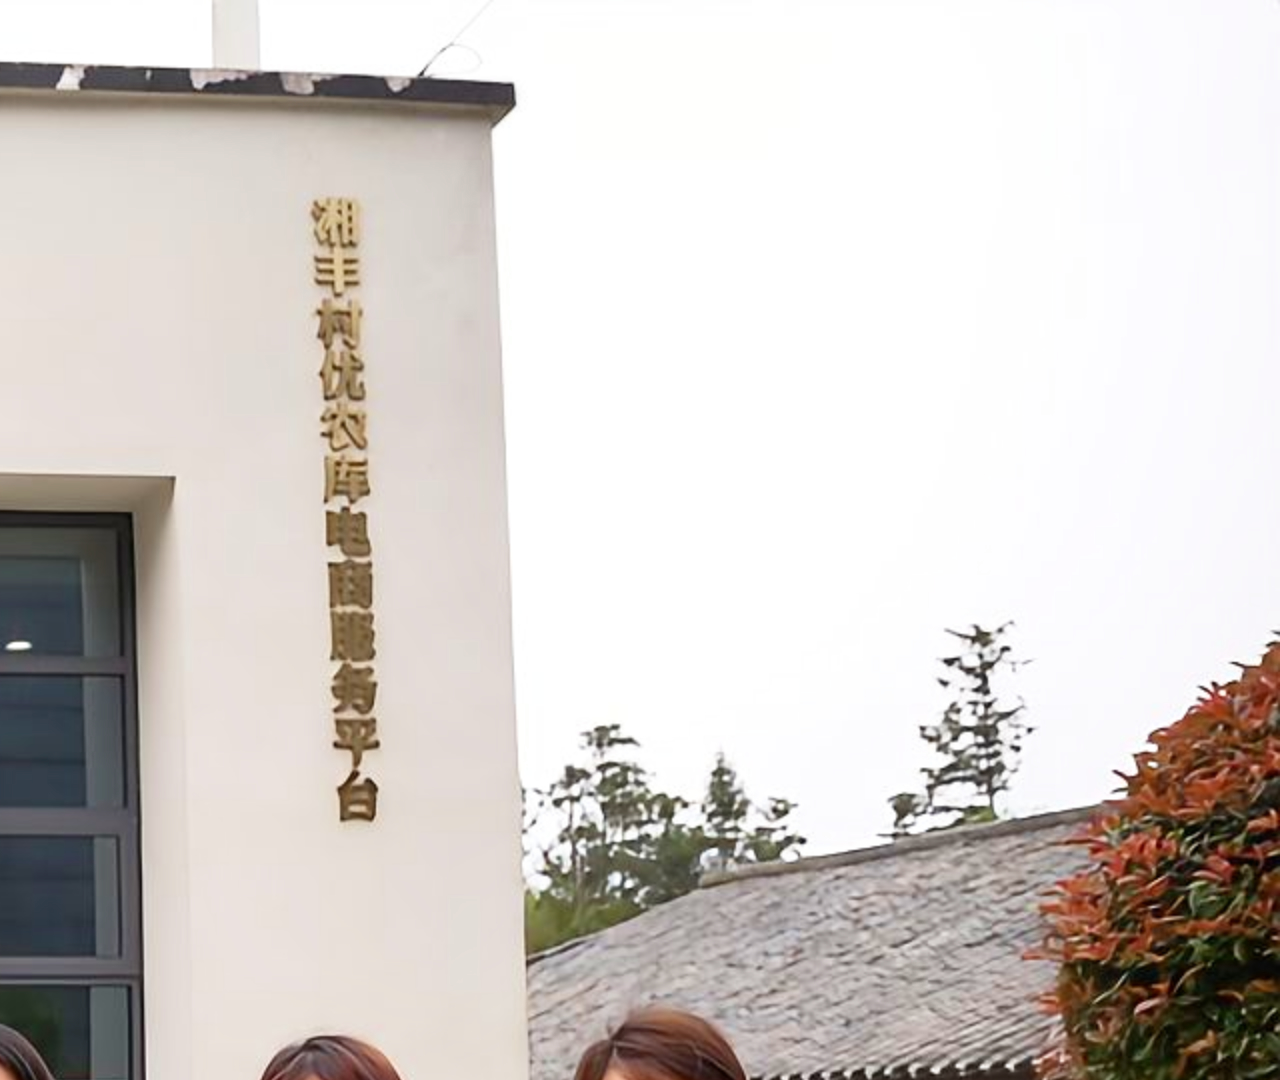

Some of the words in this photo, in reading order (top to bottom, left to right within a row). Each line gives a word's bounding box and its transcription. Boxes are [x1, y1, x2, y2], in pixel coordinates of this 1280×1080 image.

[311, 198, 379, 822] 湘丰村优农库电商服务平台
